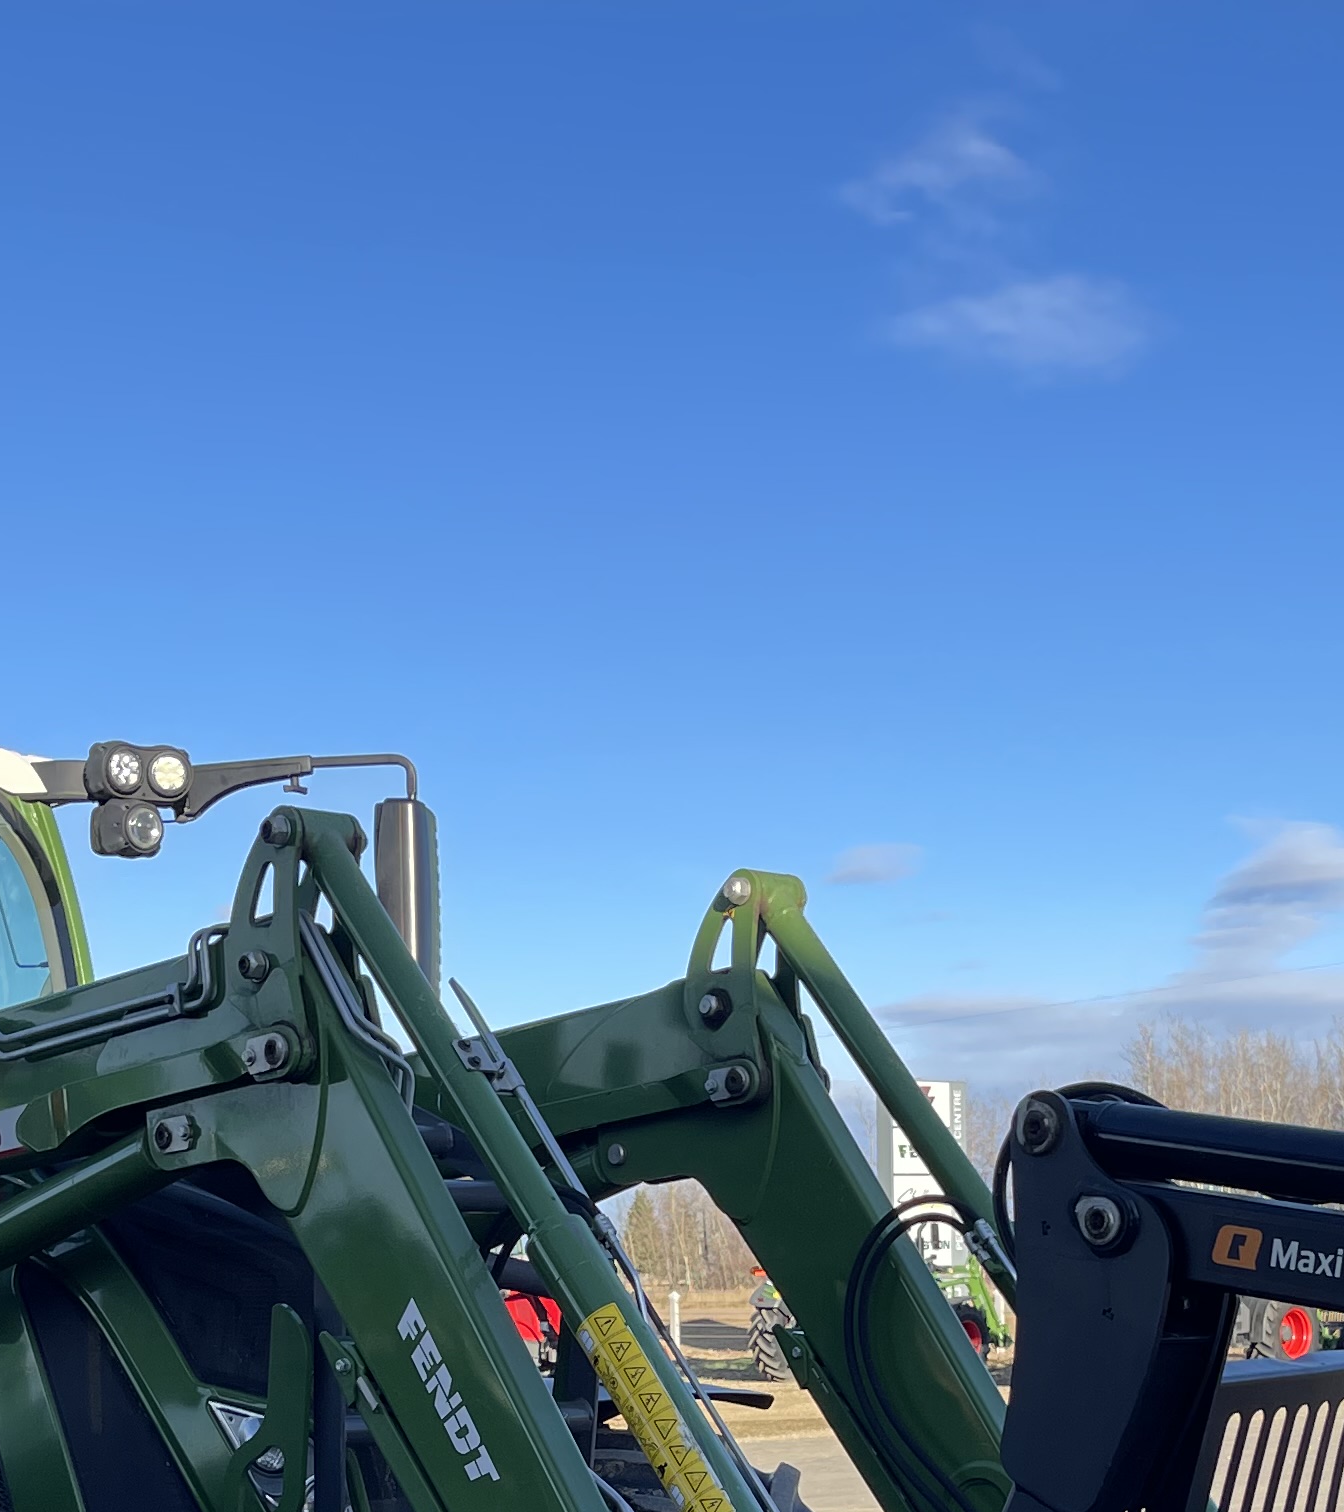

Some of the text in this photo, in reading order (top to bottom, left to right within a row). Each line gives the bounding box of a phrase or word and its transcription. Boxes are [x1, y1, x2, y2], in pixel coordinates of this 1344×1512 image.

[952, 1089, 962, 1140] CENTRE
[1269, 1238, 1344, 1278] Maxi
[395, 1296, 501, 1482] FENDT
